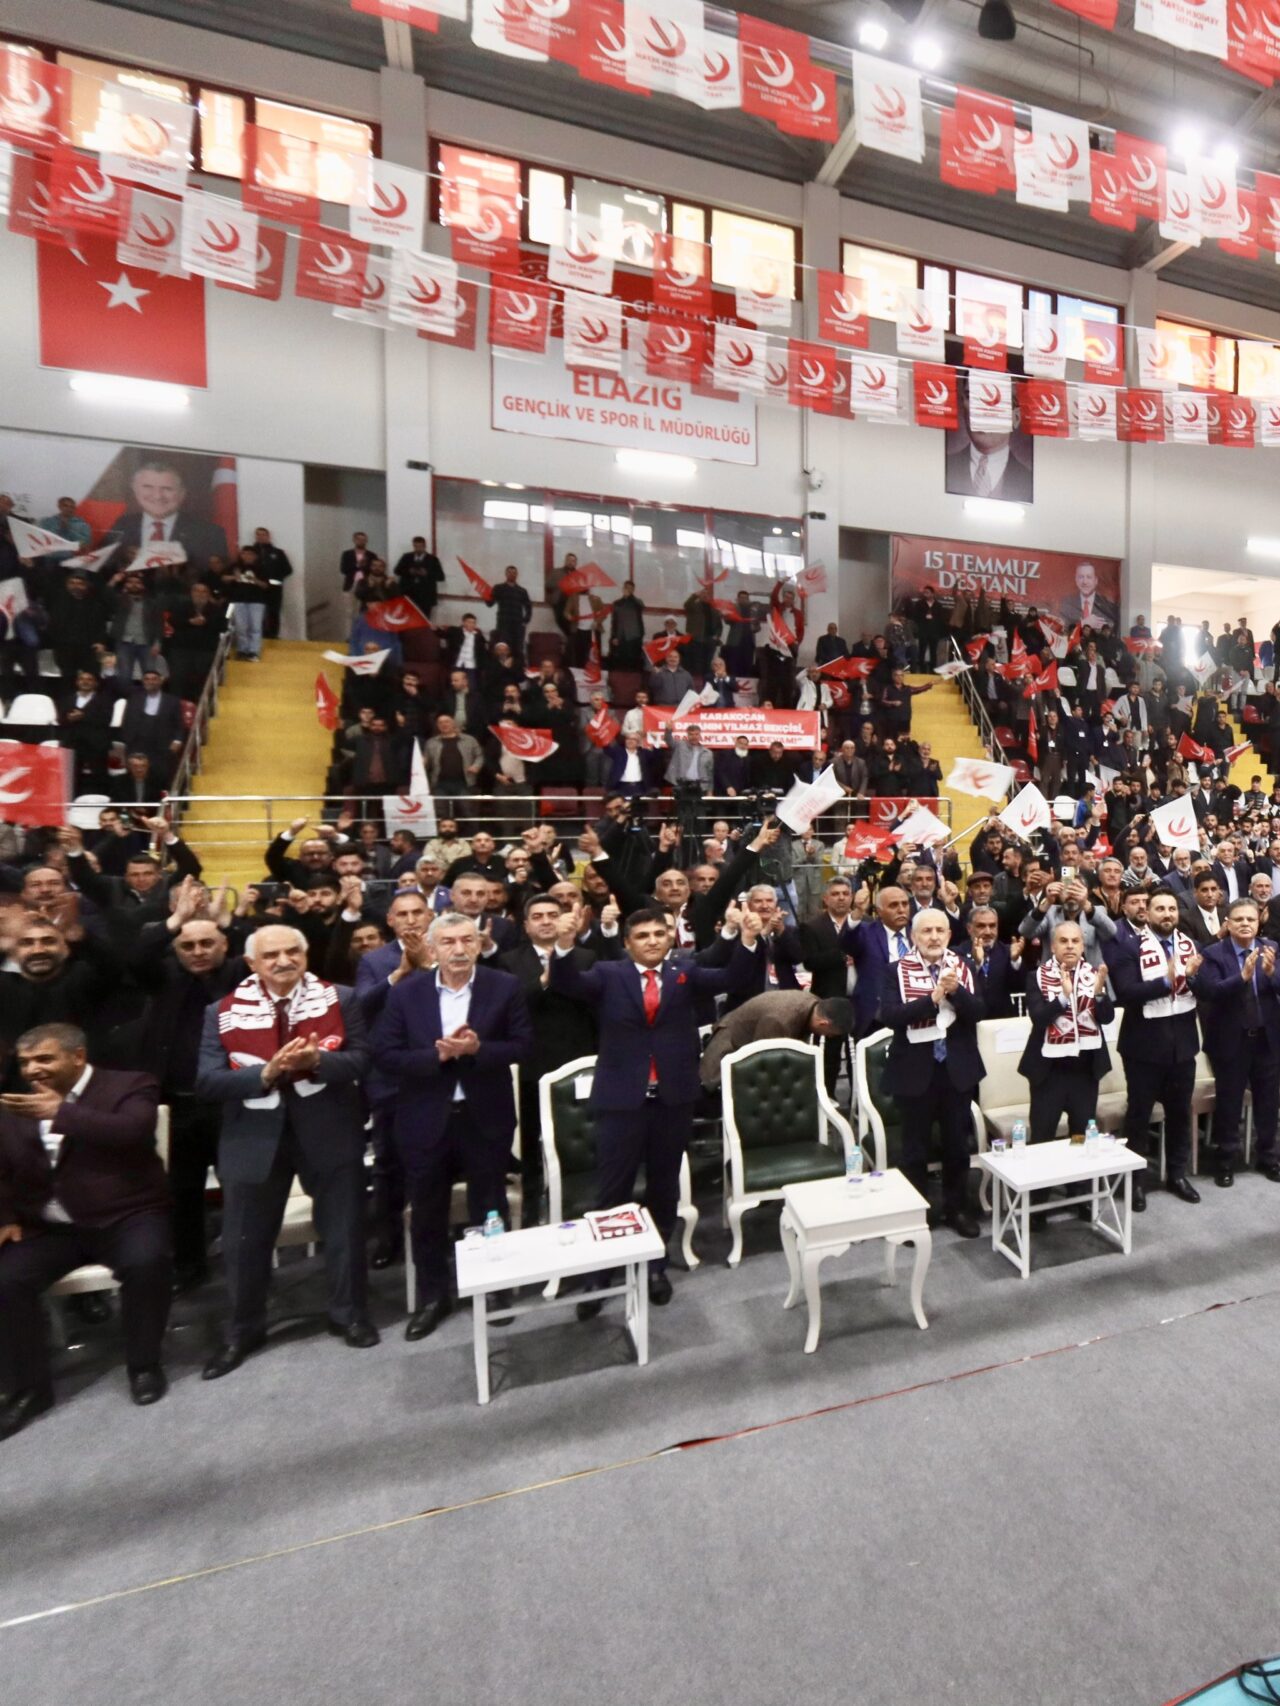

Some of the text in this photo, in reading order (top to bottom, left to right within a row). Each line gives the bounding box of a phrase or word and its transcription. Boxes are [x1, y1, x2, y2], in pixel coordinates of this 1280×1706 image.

[502, 395, 571, 420] GENÇLİK
[576, 406, 595, 422] VE
[600, 410, 639, 429] SPOR
[660, 418, 751, 446] MÜDÜRLÜĞÜ
[923, 550, 1041, 579] 15 TEMMUZ
[938, 570, 1027, 596] DESTANI
